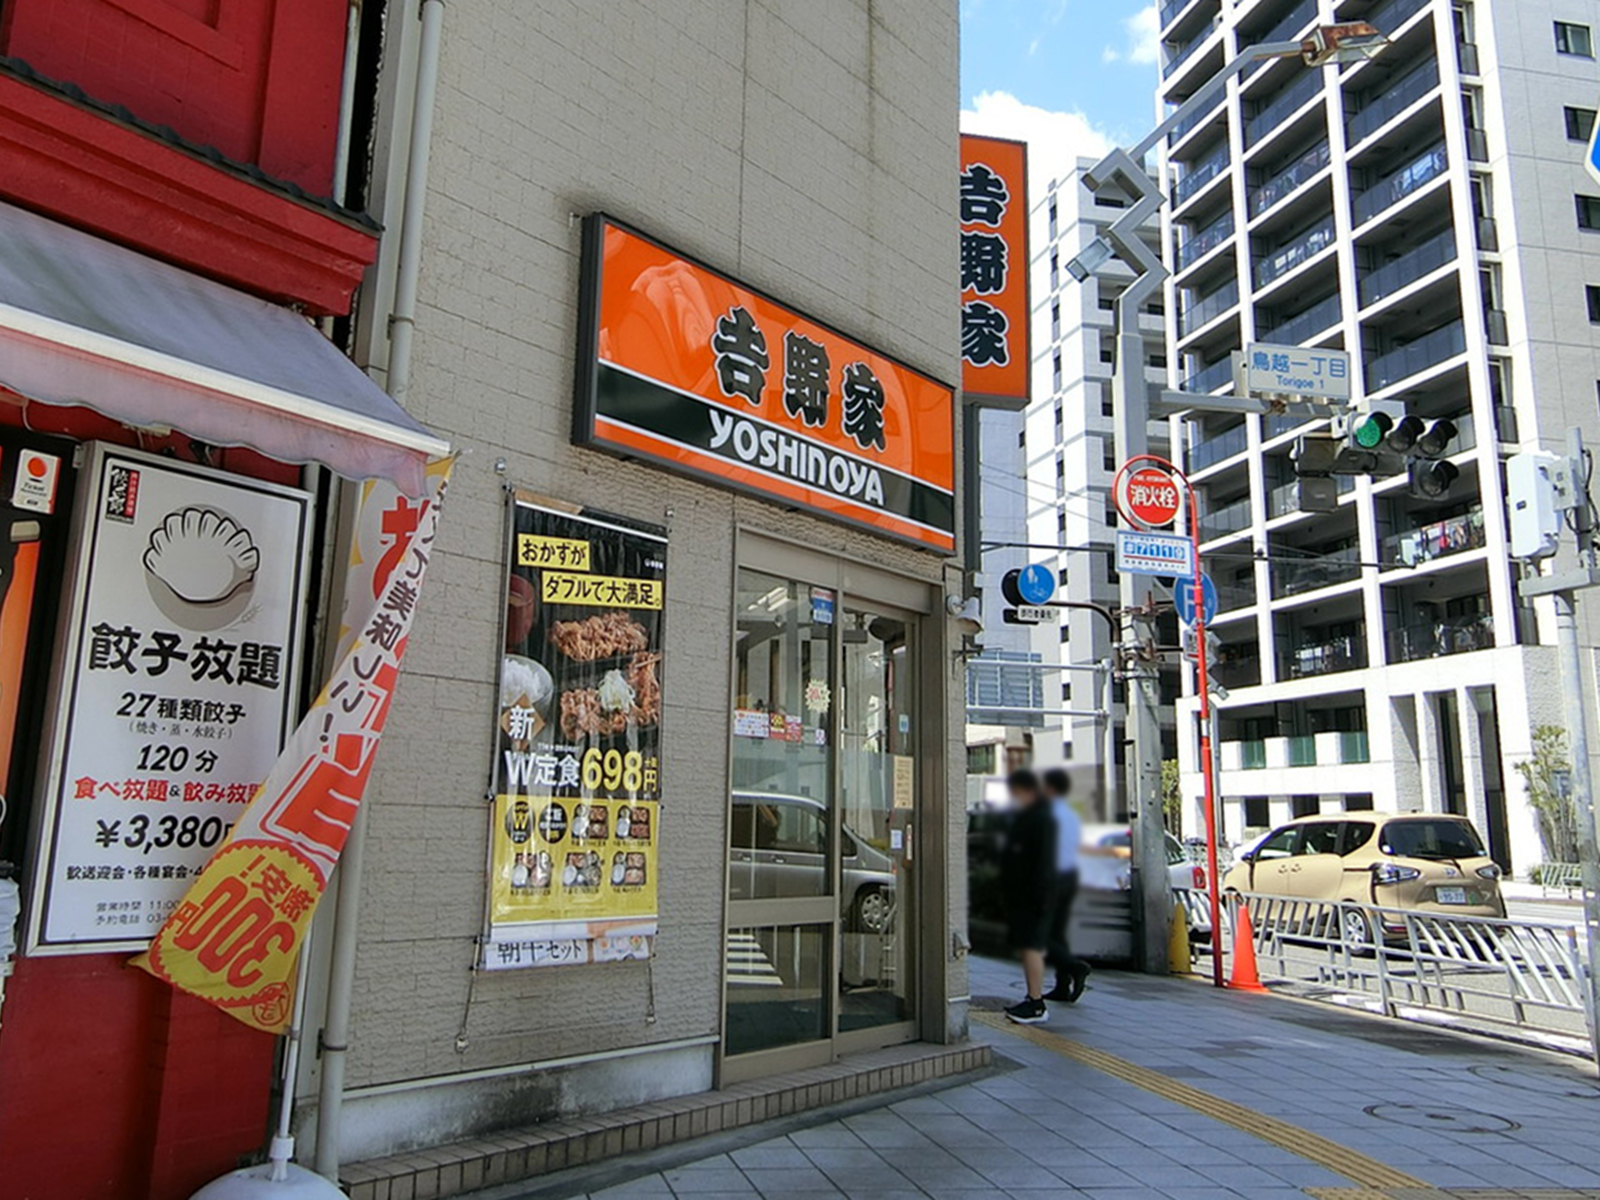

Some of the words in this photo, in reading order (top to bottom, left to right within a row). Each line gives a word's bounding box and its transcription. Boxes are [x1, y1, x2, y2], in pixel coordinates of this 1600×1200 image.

[711, 306, 886, 451] 吉野家
[1252, 351, 1346, 378] 鳥越一丁目
[1276, 375, 1314, 389] Torigoe
[708, 409, 884, 506] YOSHINOYA
[1130, 484, 1176, 509] 消火栓
[88, 622, 282, 690] 餃子放題
[117, 692, 246, 725] 27種類餃子
[509, 705, 535, 740] 新
[504, 750, 580, 788] W定食
